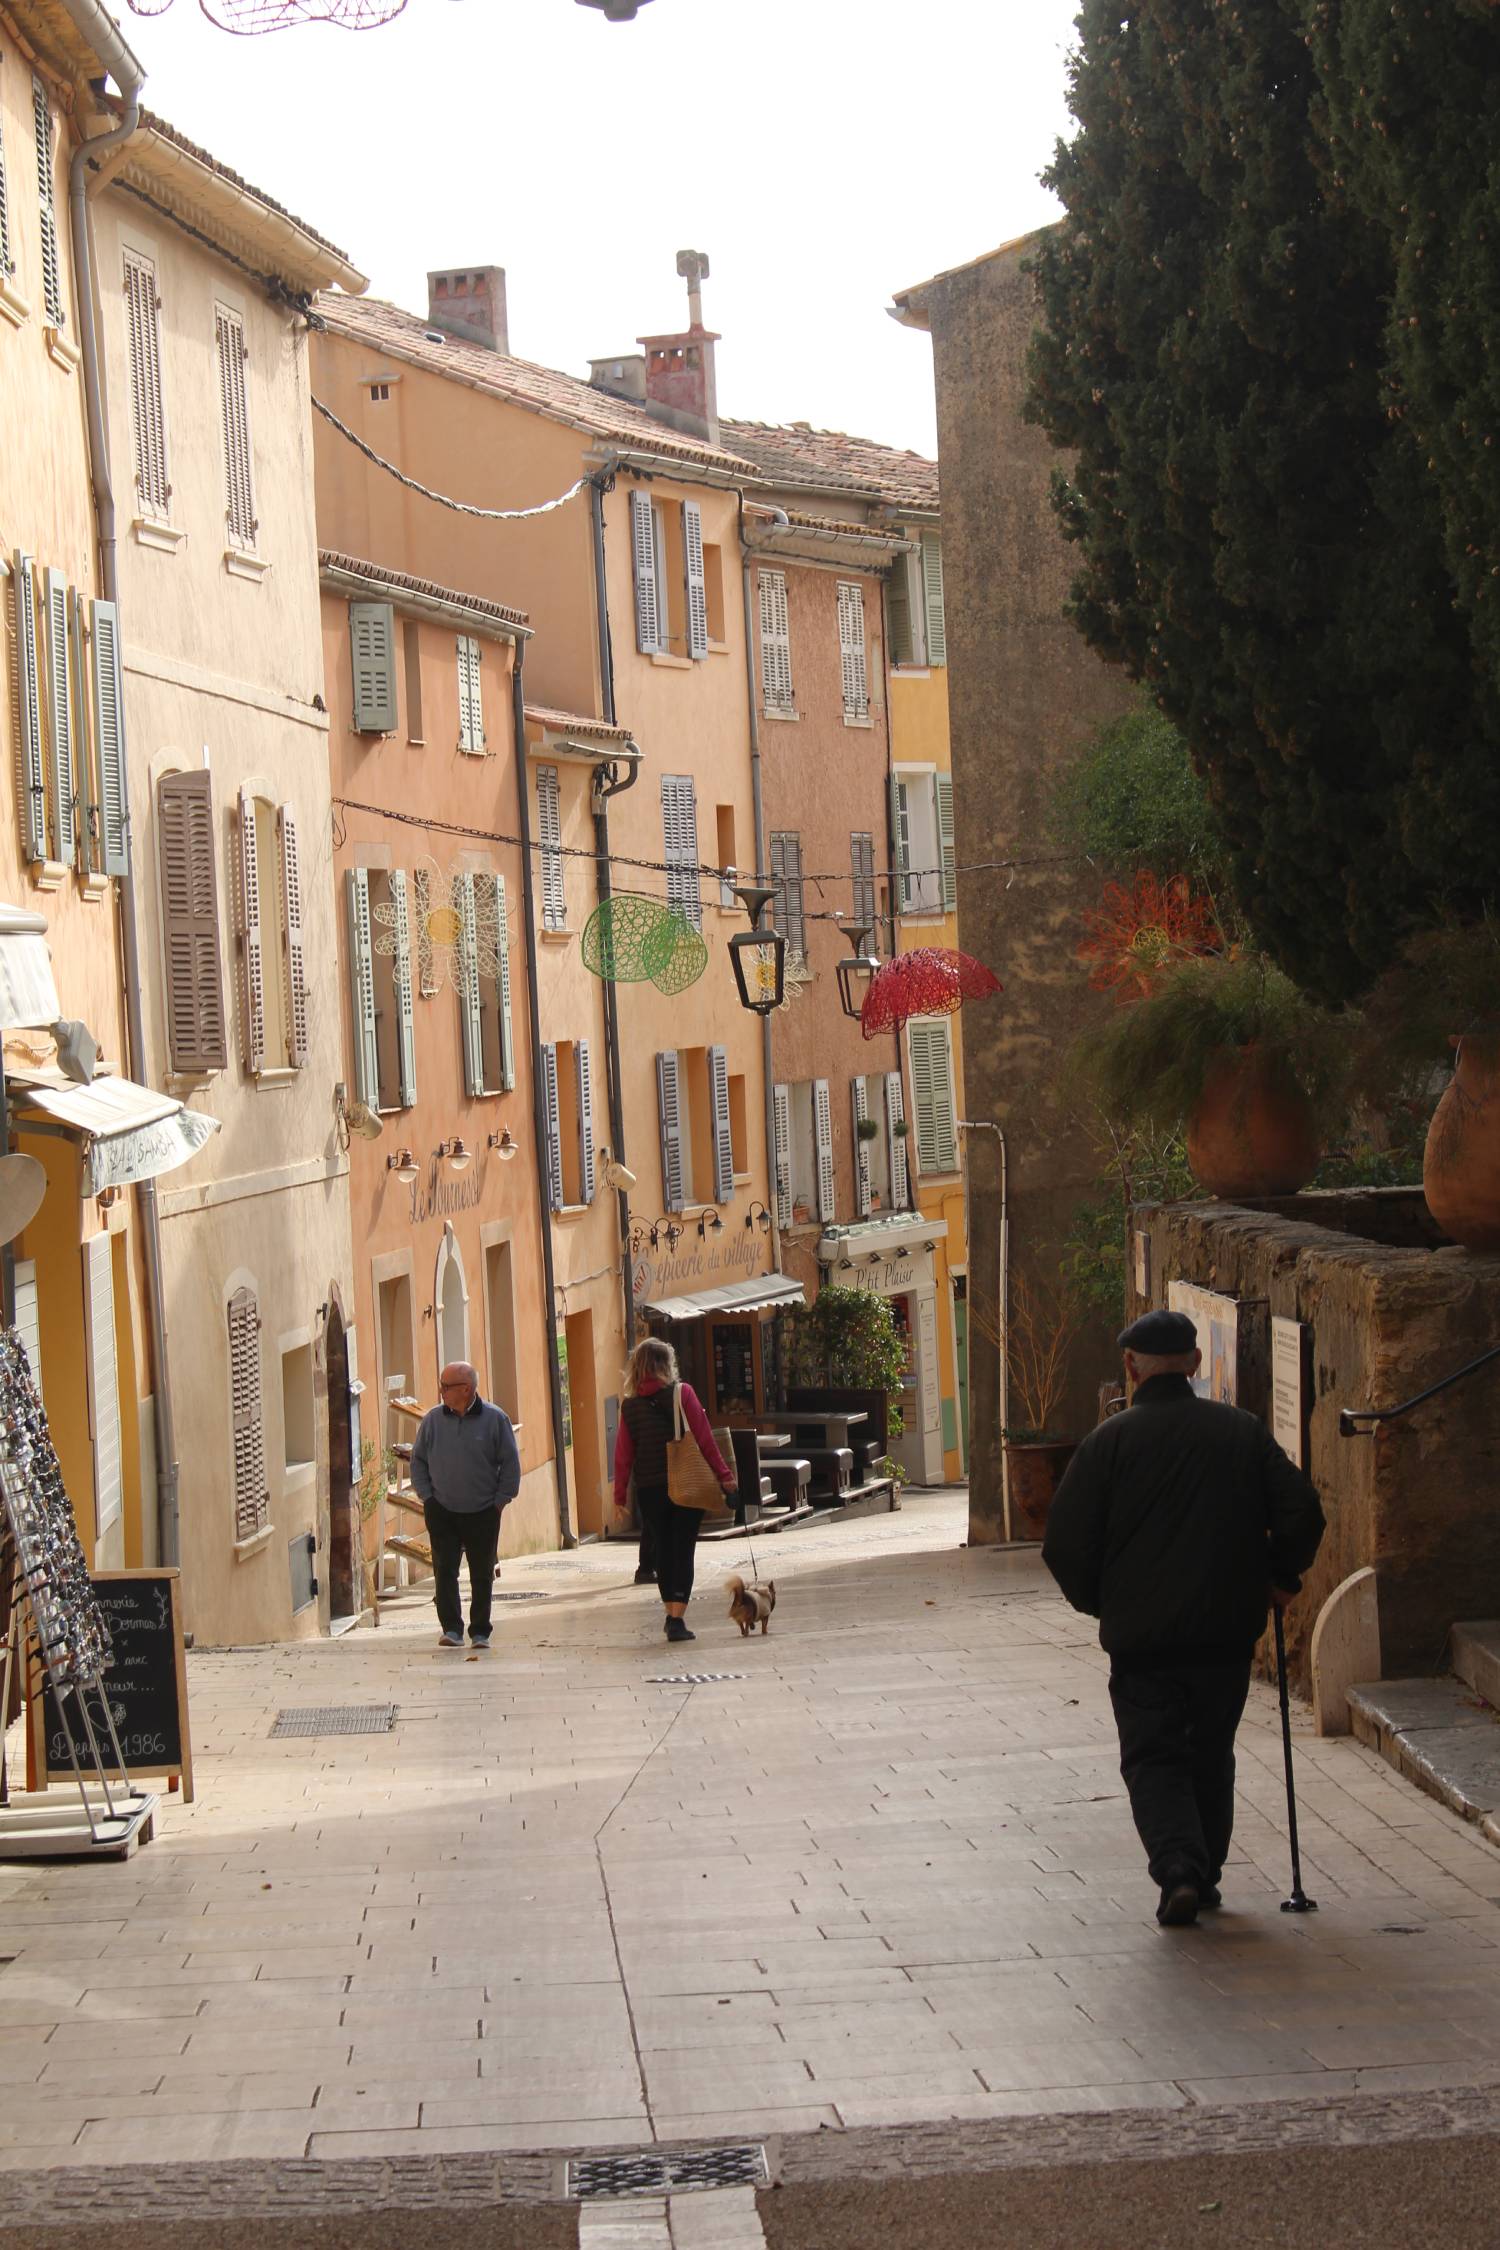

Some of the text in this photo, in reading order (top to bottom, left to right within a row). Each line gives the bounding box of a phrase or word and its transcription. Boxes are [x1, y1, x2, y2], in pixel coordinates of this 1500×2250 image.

[707, 1247, 720, 1270] du
[724, 1231, 763, 1277] village
[883, 1260, 914, 1287] Plaisir
[121, 1732, 166, 1757] 1986
